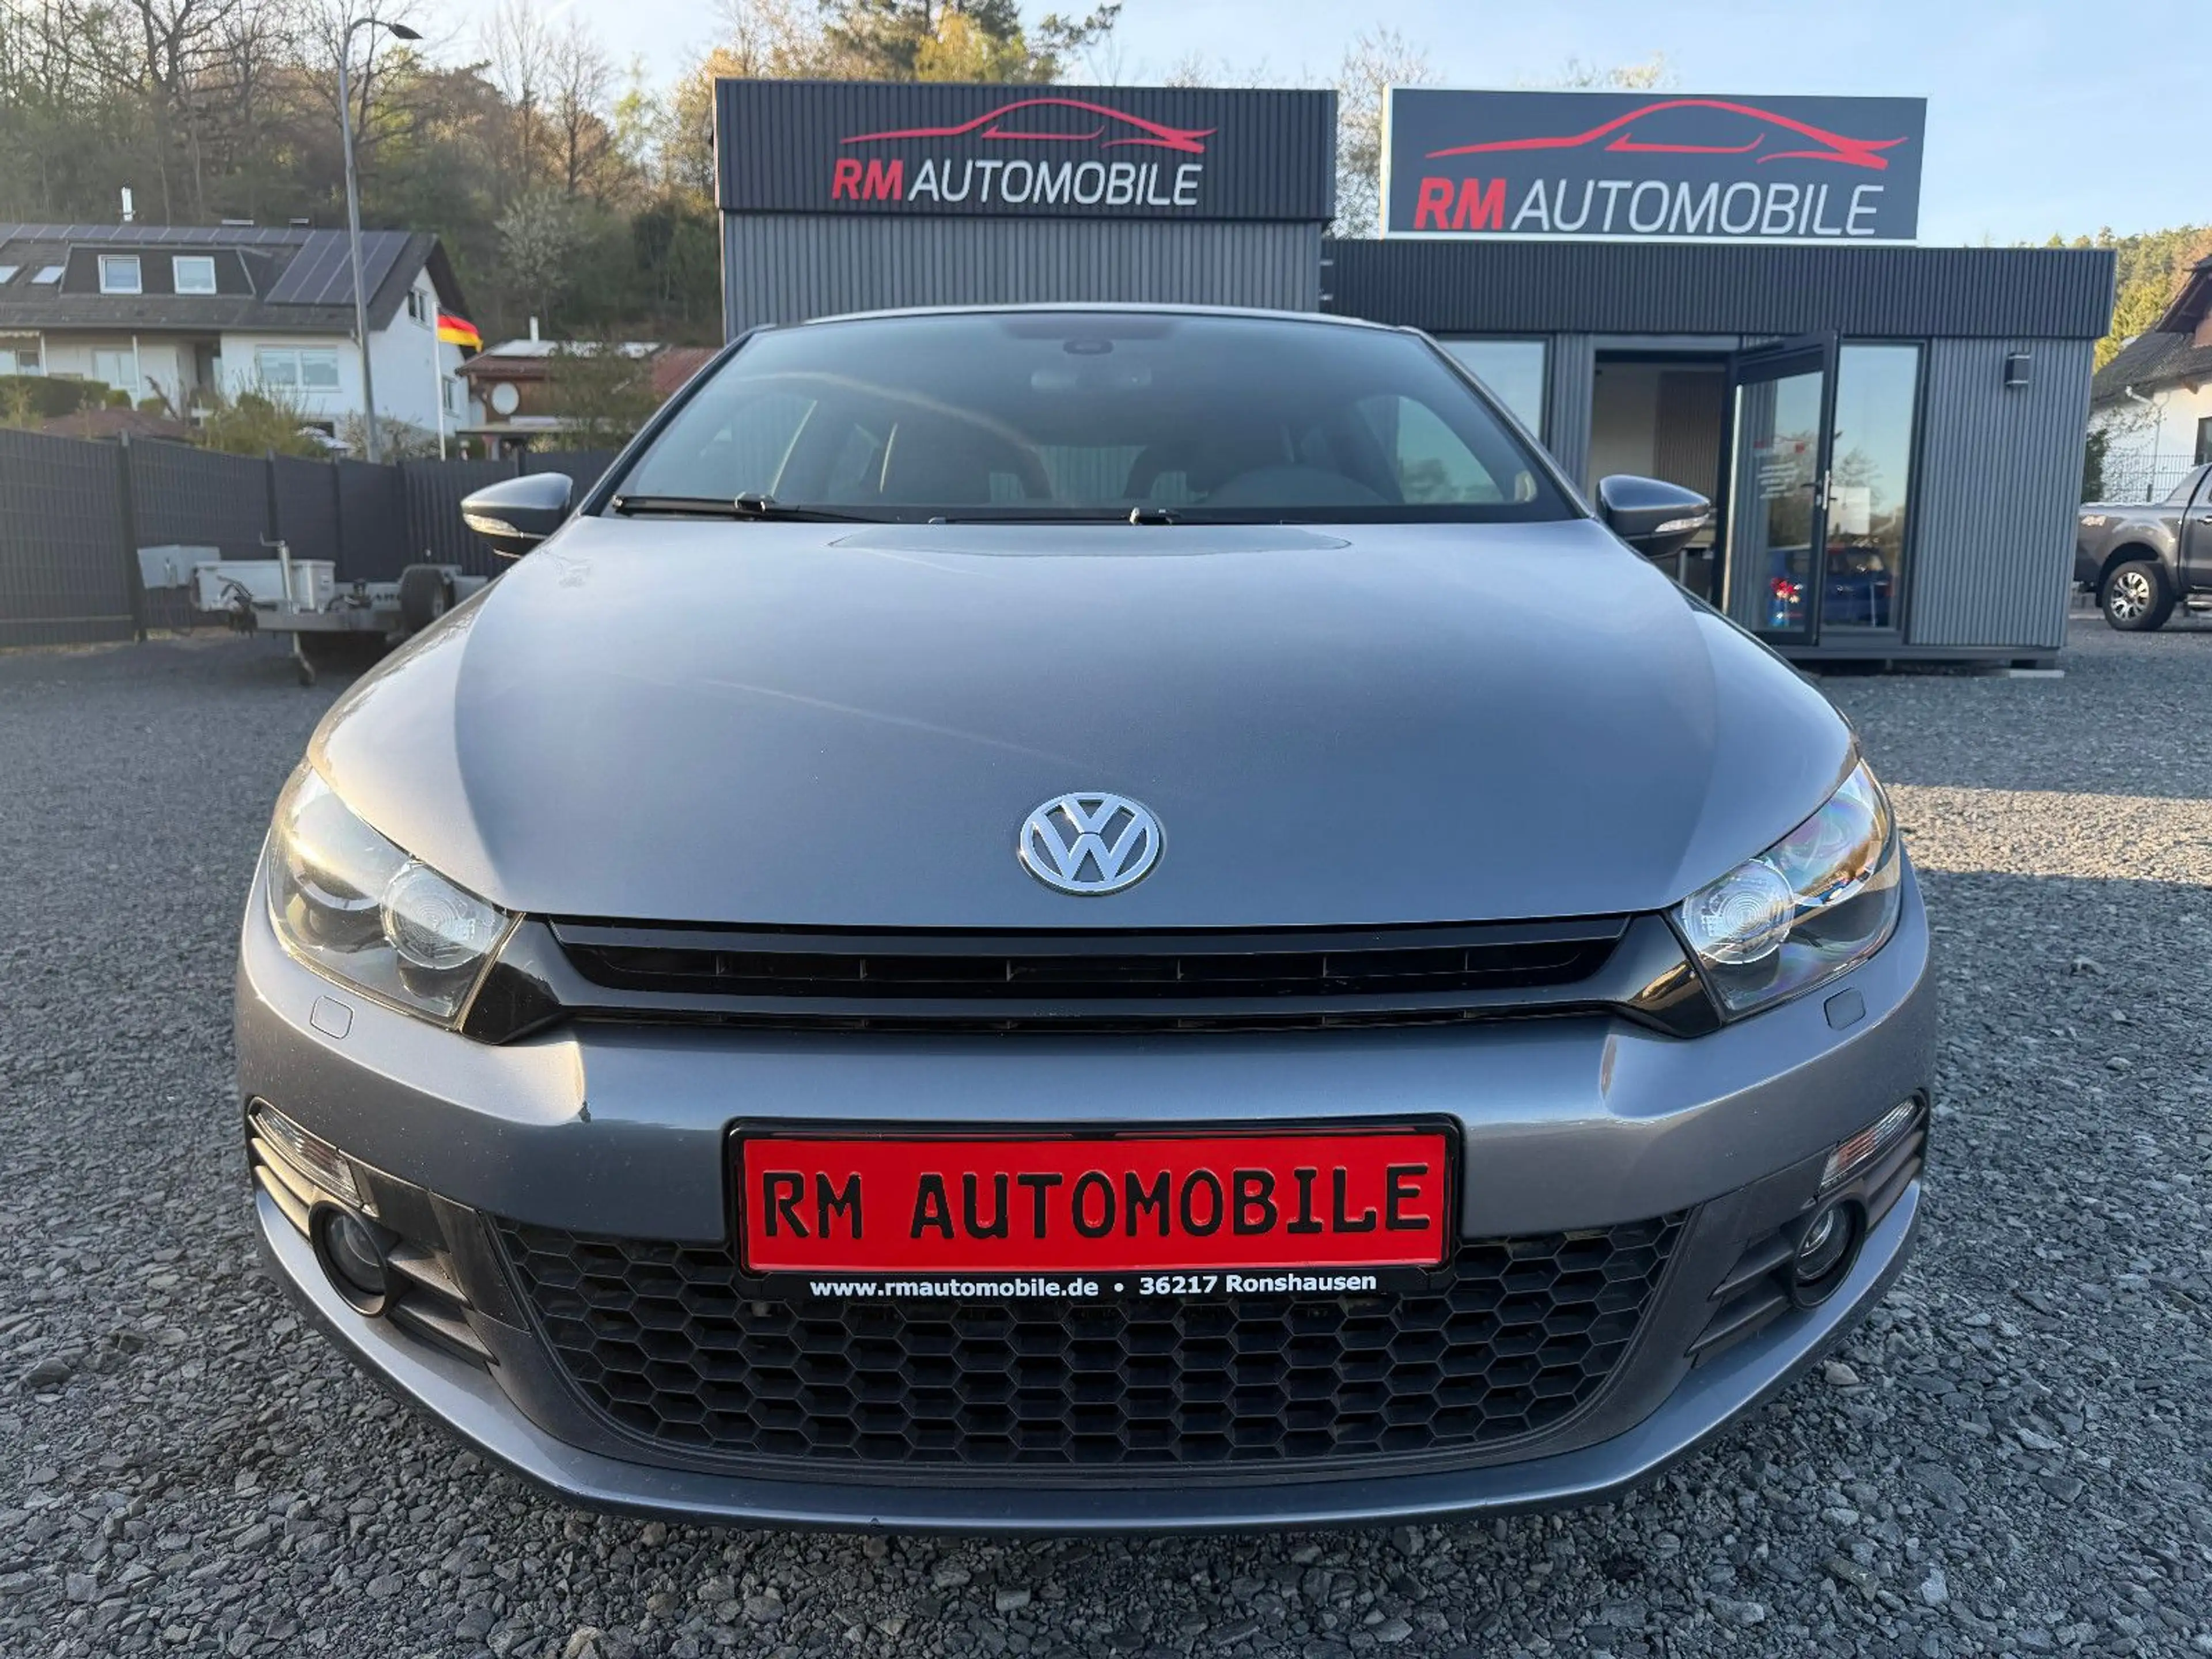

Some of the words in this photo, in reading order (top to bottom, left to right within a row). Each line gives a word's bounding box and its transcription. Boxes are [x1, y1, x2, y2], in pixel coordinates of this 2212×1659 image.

[832, 158, 904, 200] RM
[908, 160, 1203, 206] AUTOMOBILE
[1414, 177, 1506, 230] RM
[1511, 179, 1884, 236] AUTOMOBILE
[1020, 791, 1160, 892] VW
[763, 1171, 862, 1240] RM
[910, 1162, 1431, 1239] AUTOMOBILE
[810, 1278, 1099, 1297] www.rmautomobile.de
[1139, 1275, 1218, 1295] 36217
[1226, 1272, 1377, 1294] Ronshausen
